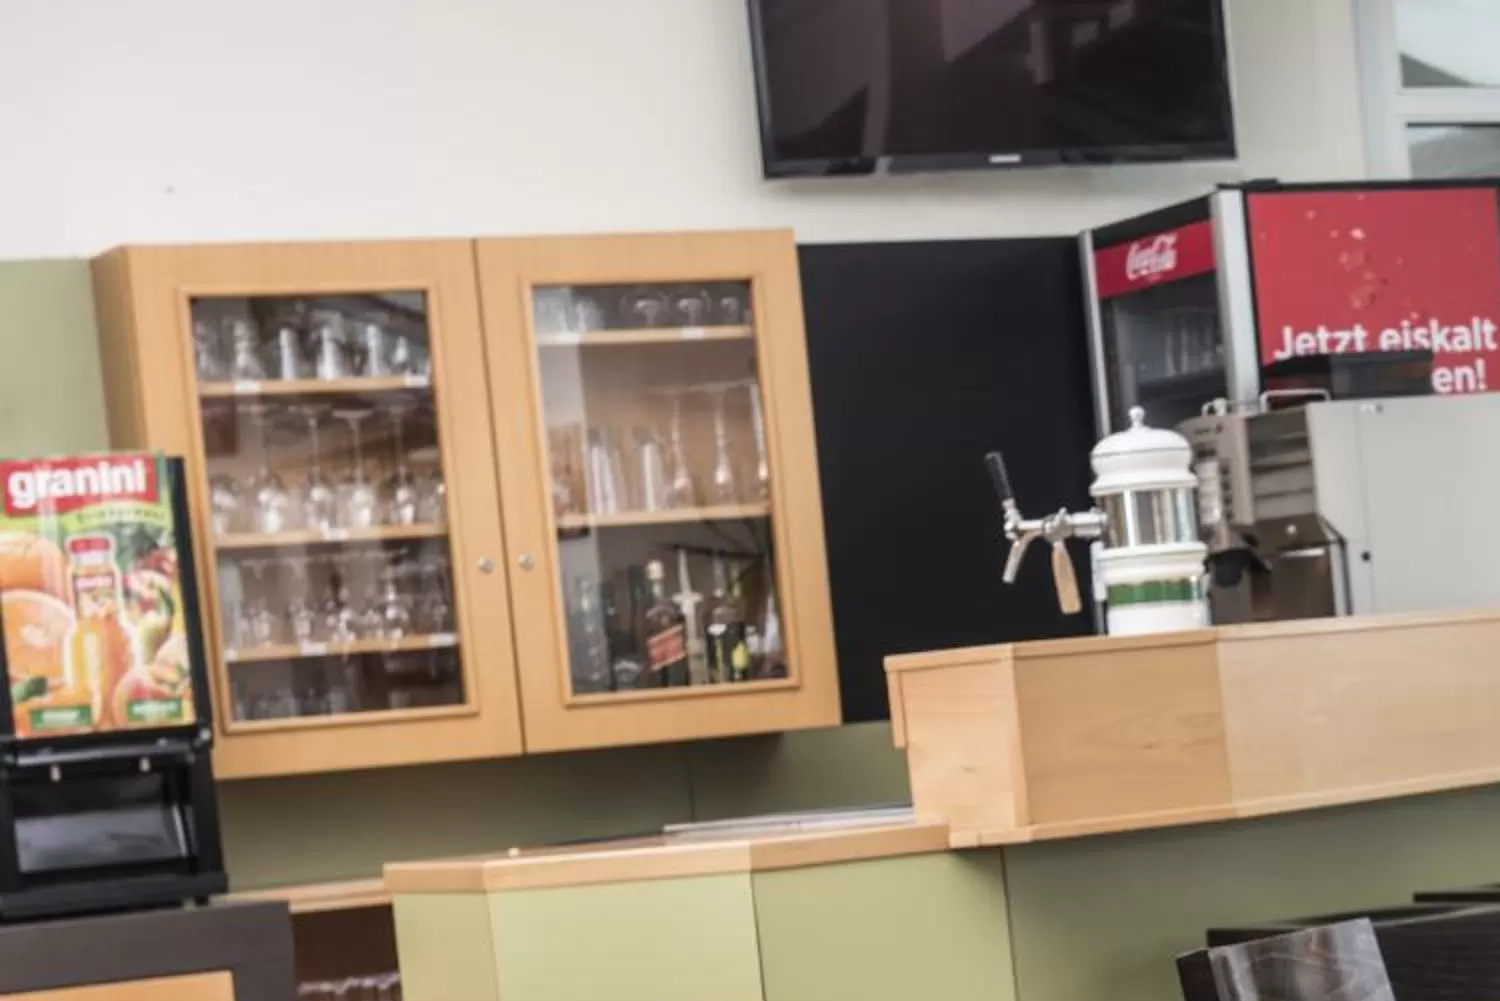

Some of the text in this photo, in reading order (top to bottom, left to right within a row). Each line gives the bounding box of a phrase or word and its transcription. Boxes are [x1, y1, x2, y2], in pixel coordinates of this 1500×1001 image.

[1275, 316, 1498, 360] Jetzt eiskalt
[1431, 358, 1487, 393] en!
[8, 458, 148, 509] granini
